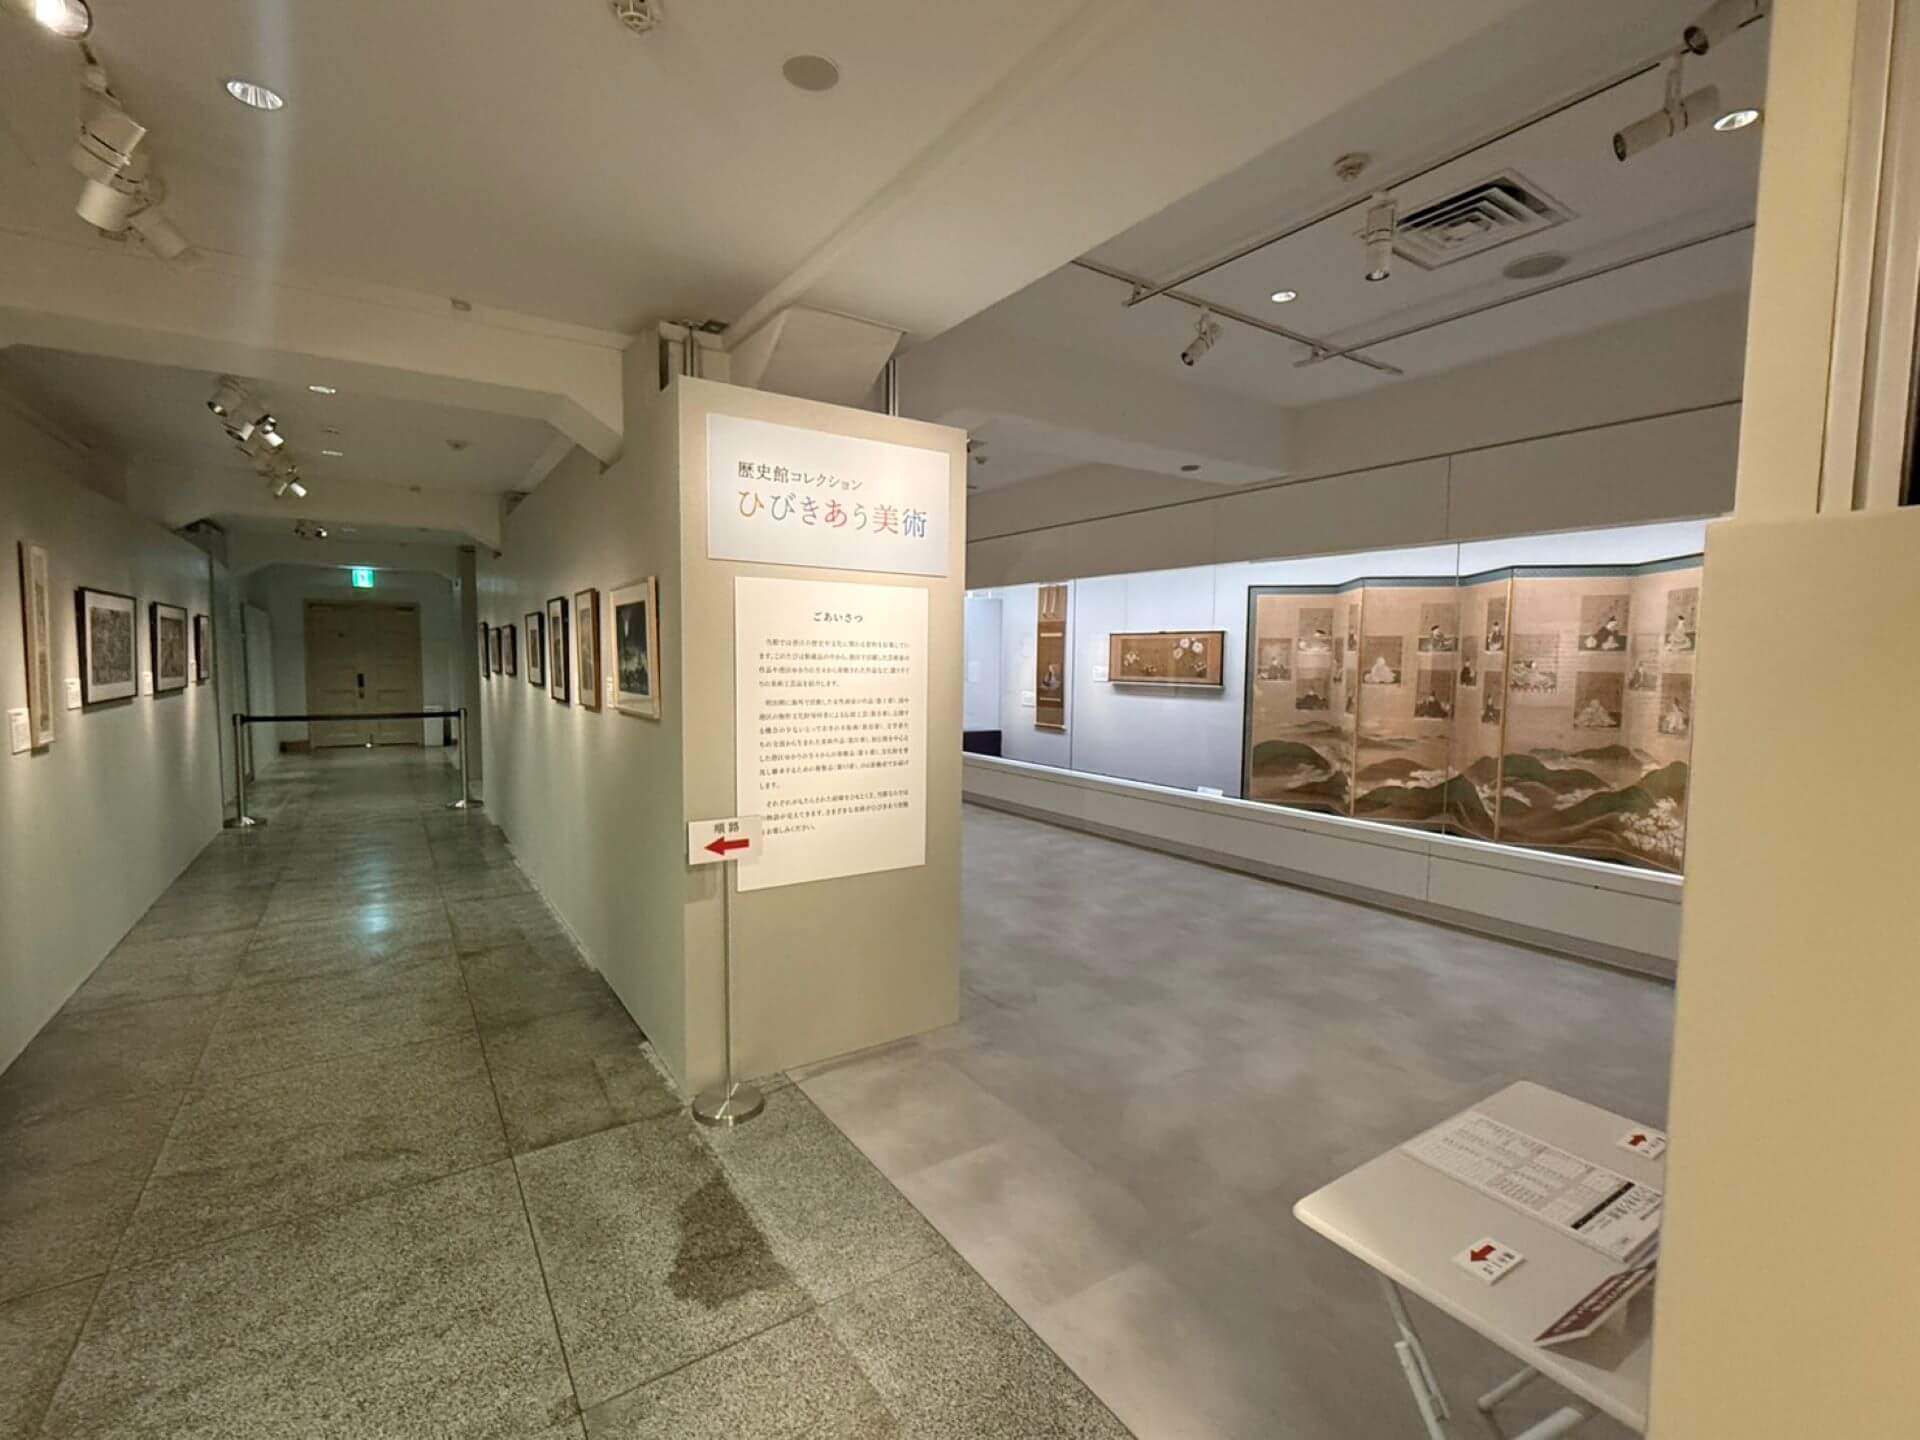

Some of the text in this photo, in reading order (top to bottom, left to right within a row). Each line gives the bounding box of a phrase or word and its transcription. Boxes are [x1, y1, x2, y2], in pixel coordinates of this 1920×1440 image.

[737, 461, 863, 491] 歴史館コレクション
[737, 490, 927, 538] ひびきあう美術
[812, 612, 864, 623] ごあいさつ
